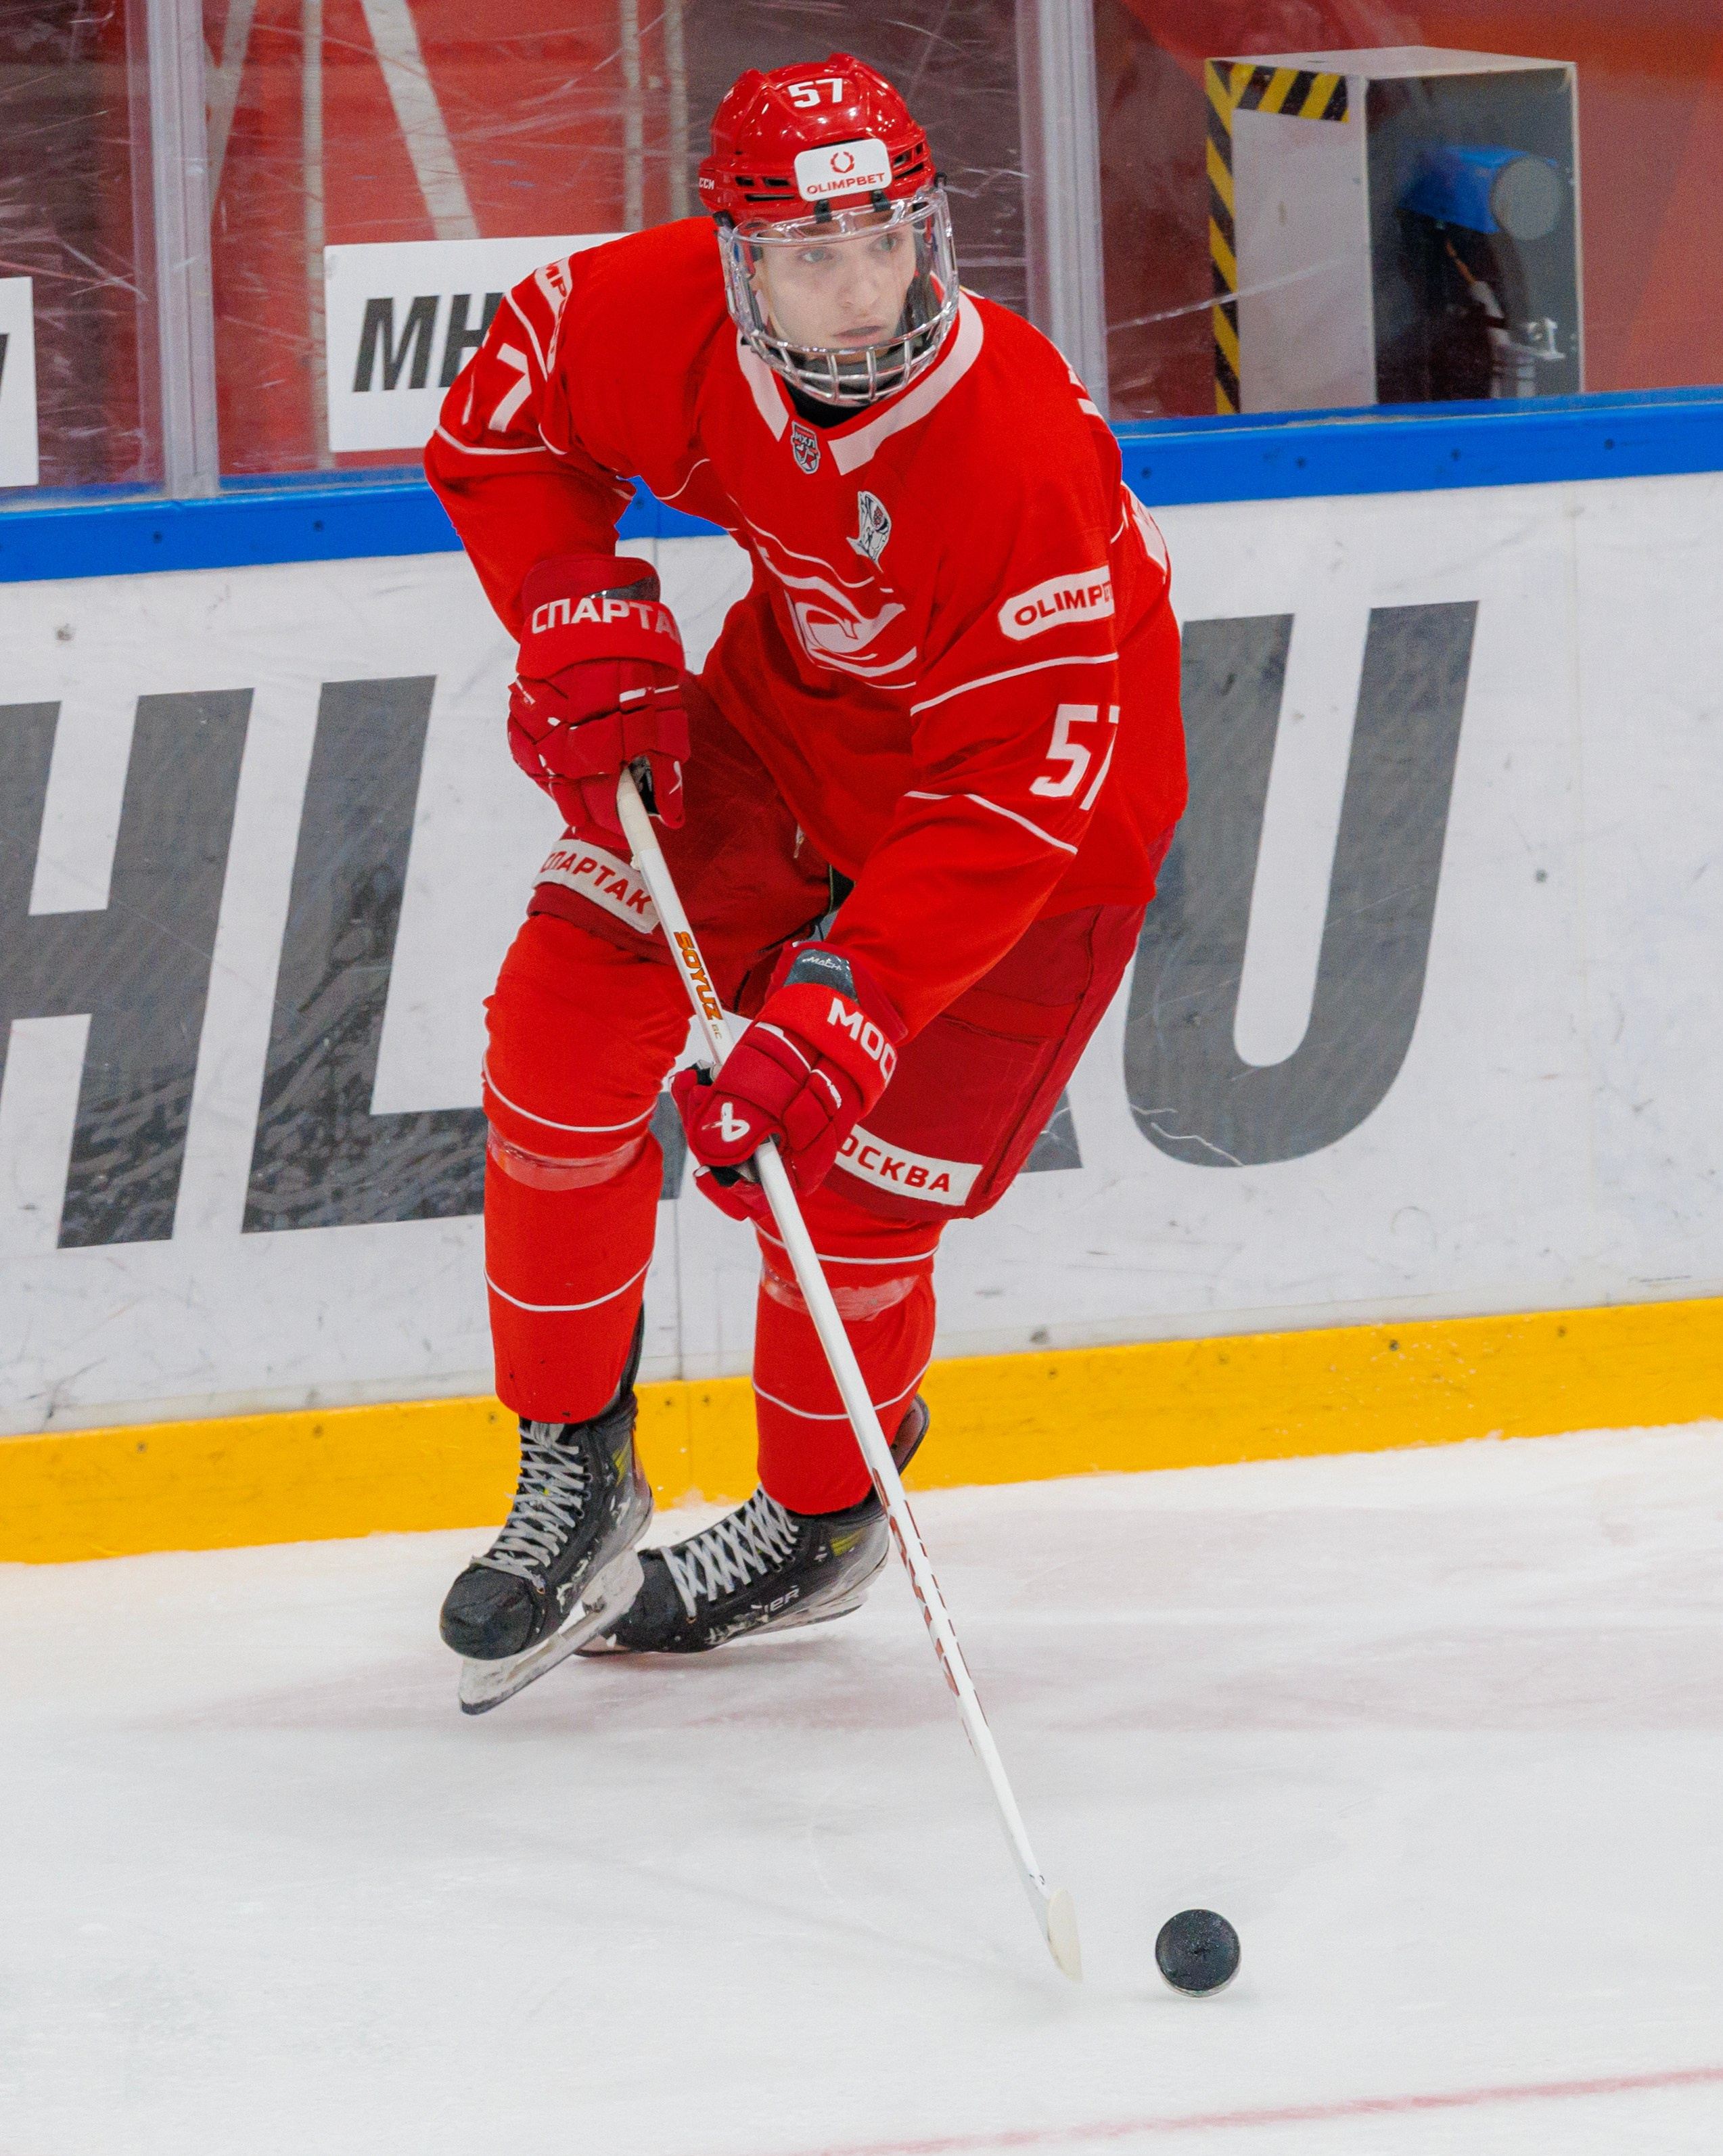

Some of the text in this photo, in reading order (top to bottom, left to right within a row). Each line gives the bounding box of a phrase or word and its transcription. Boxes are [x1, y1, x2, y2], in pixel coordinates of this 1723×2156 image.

[787, 78, 843, 108] 57
[699, 177, 715, 190] CCM
[807, 173, 885, 194] OLIMPBET
[674, 931, 723, 1020] SOYUZ
